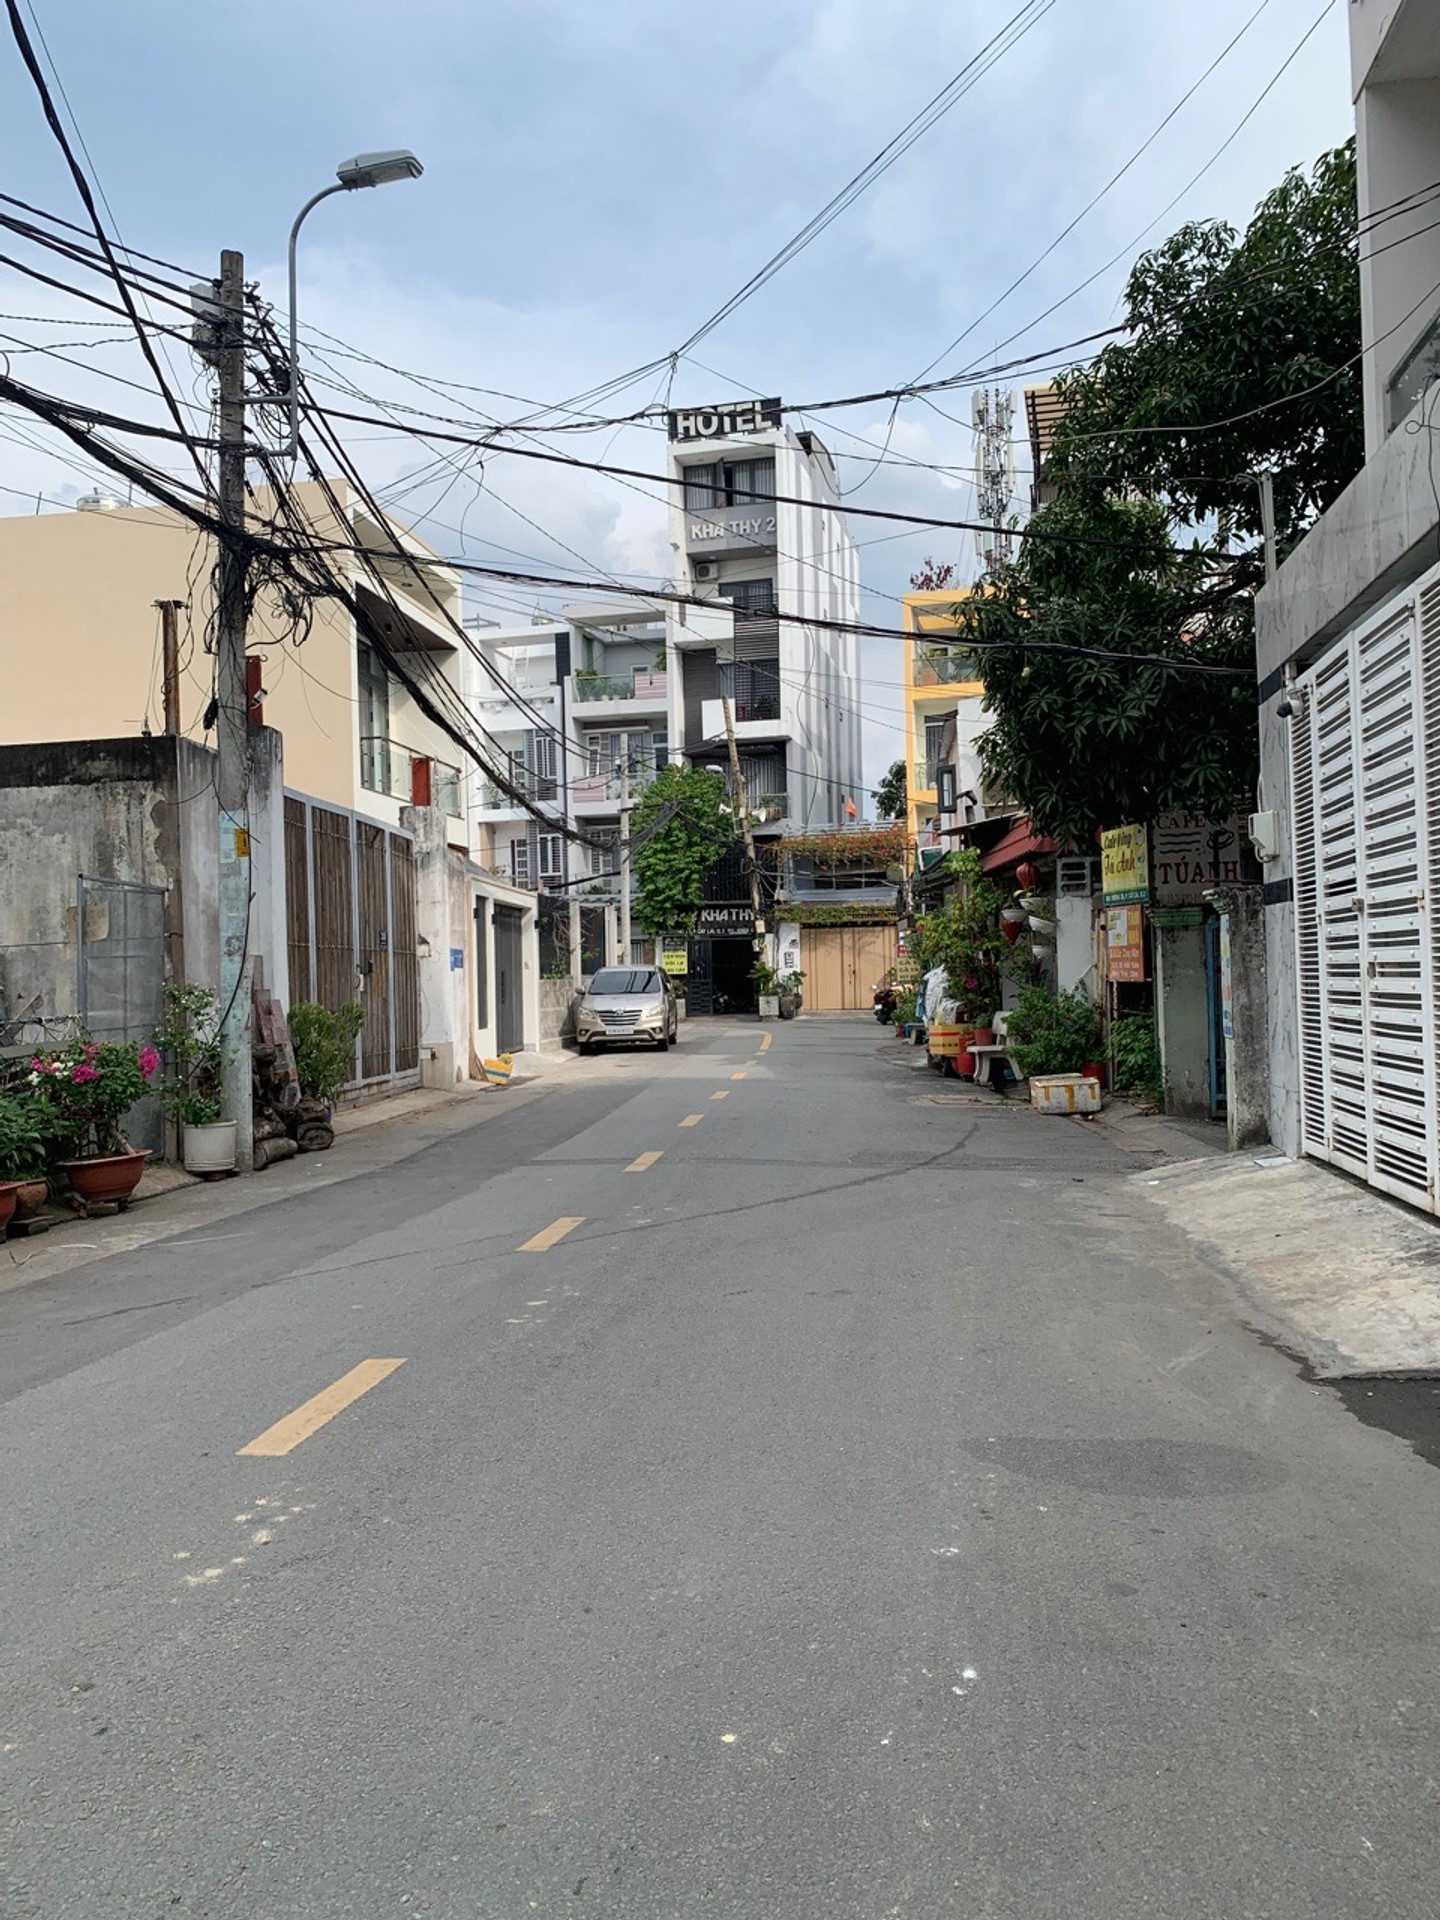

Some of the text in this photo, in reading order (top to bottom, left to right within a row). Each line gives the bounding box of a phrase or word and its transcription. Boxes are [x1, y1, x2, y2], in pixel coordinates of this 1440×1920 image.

[676, 401, 772, 438] HOTEL
[691, 516, 776, 539] KHA THY 2
